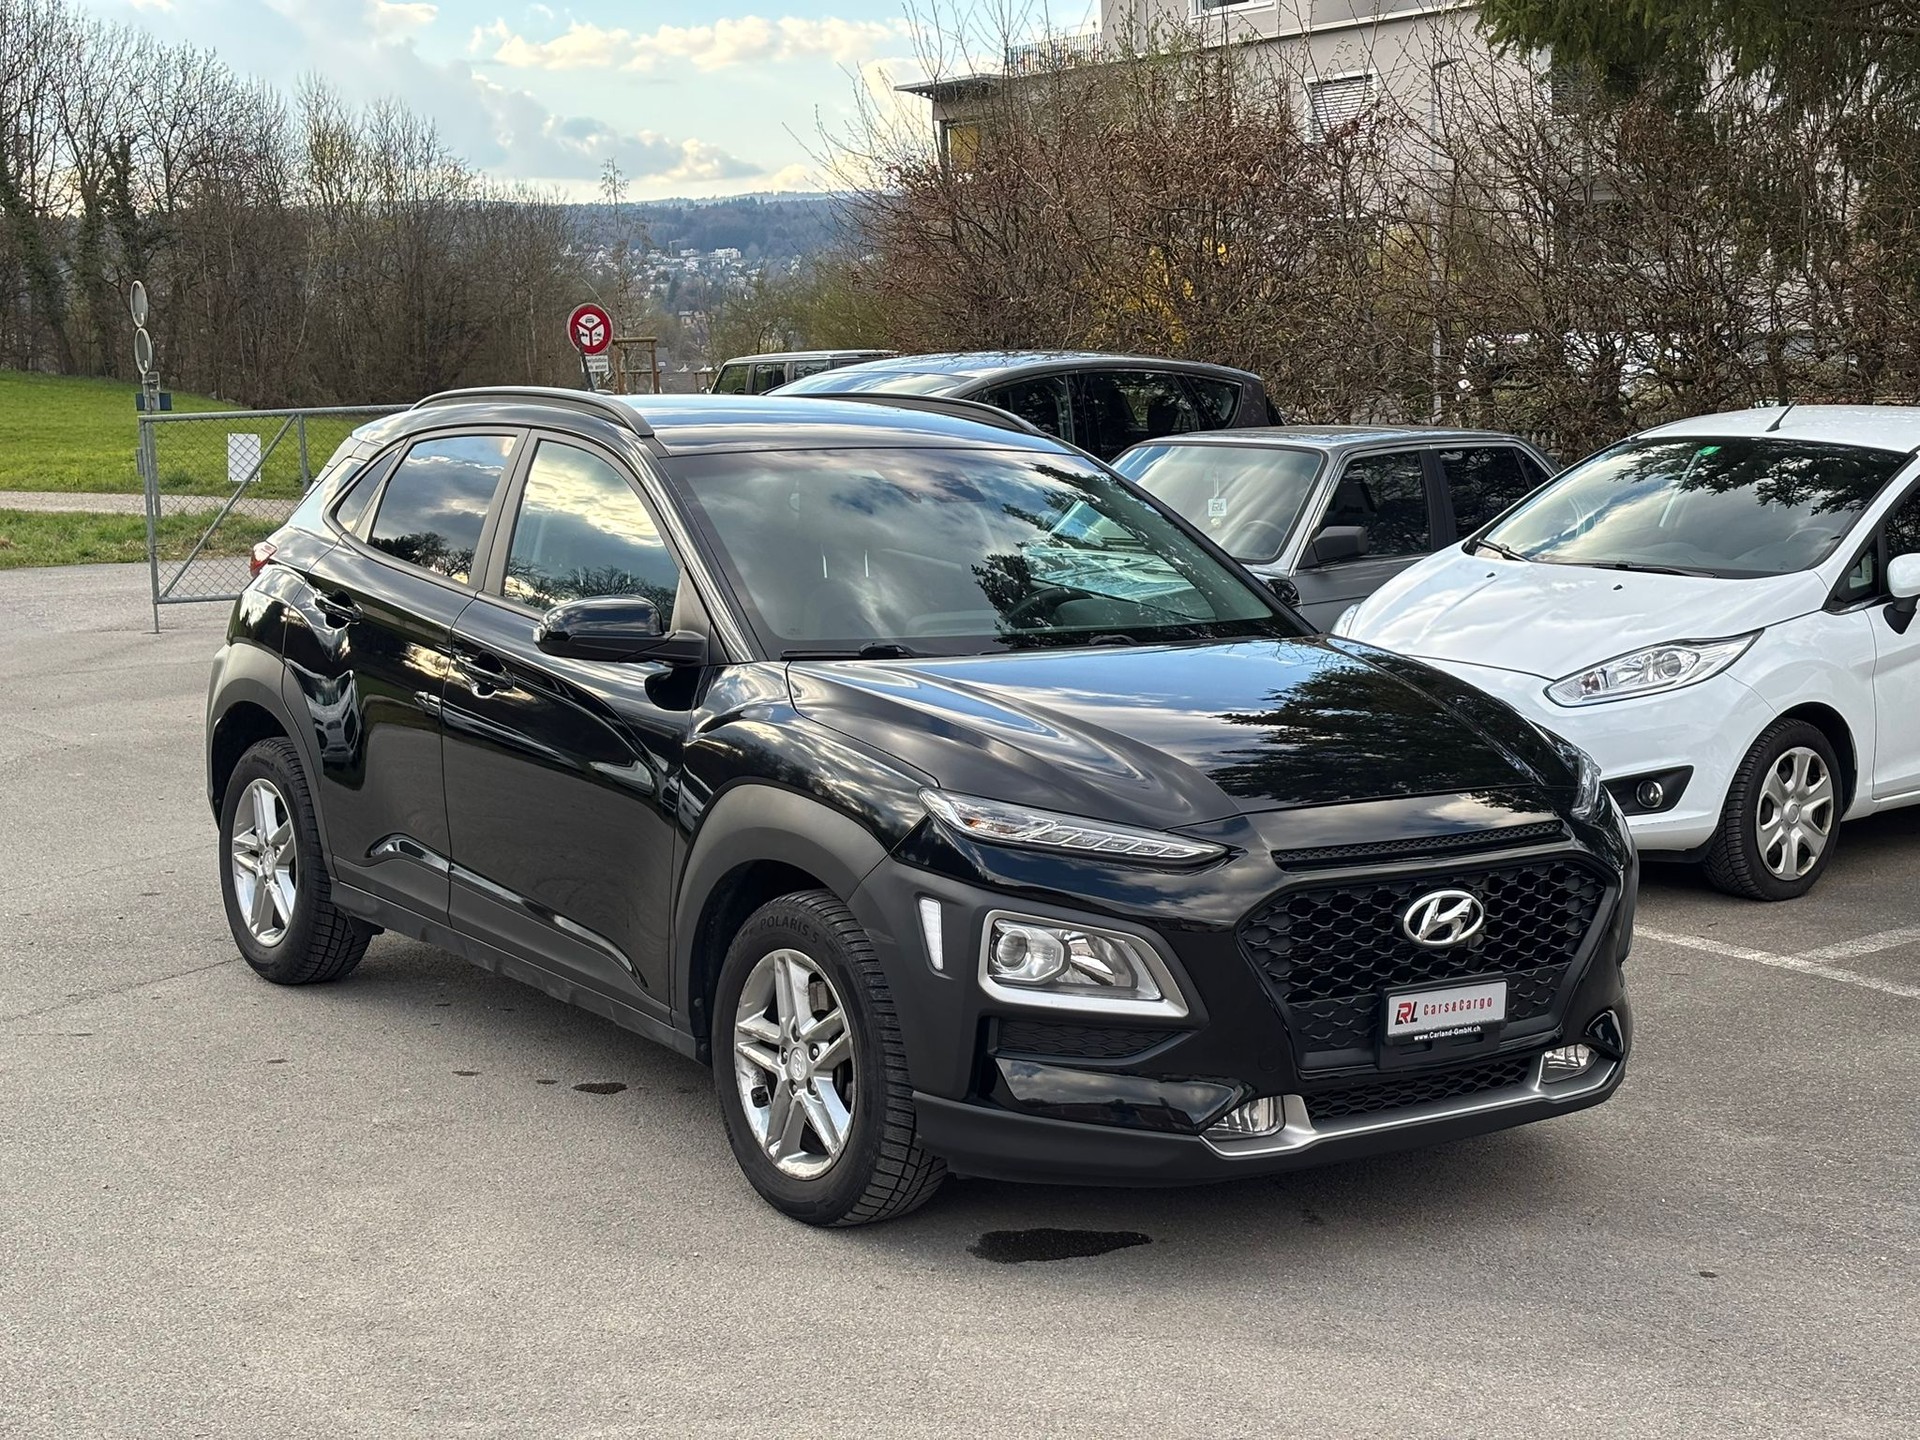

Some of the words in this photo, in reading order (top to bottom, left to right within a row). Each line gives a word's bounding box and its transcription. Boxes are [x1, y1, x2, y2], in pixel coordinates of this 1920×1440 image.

[760, 915, 809, 937] POLARIS
[1423, 997, 1493, 1016] Cars&Cargo
[1414, 1026, 1481, 1041] www.Carland-GmbH.ch
